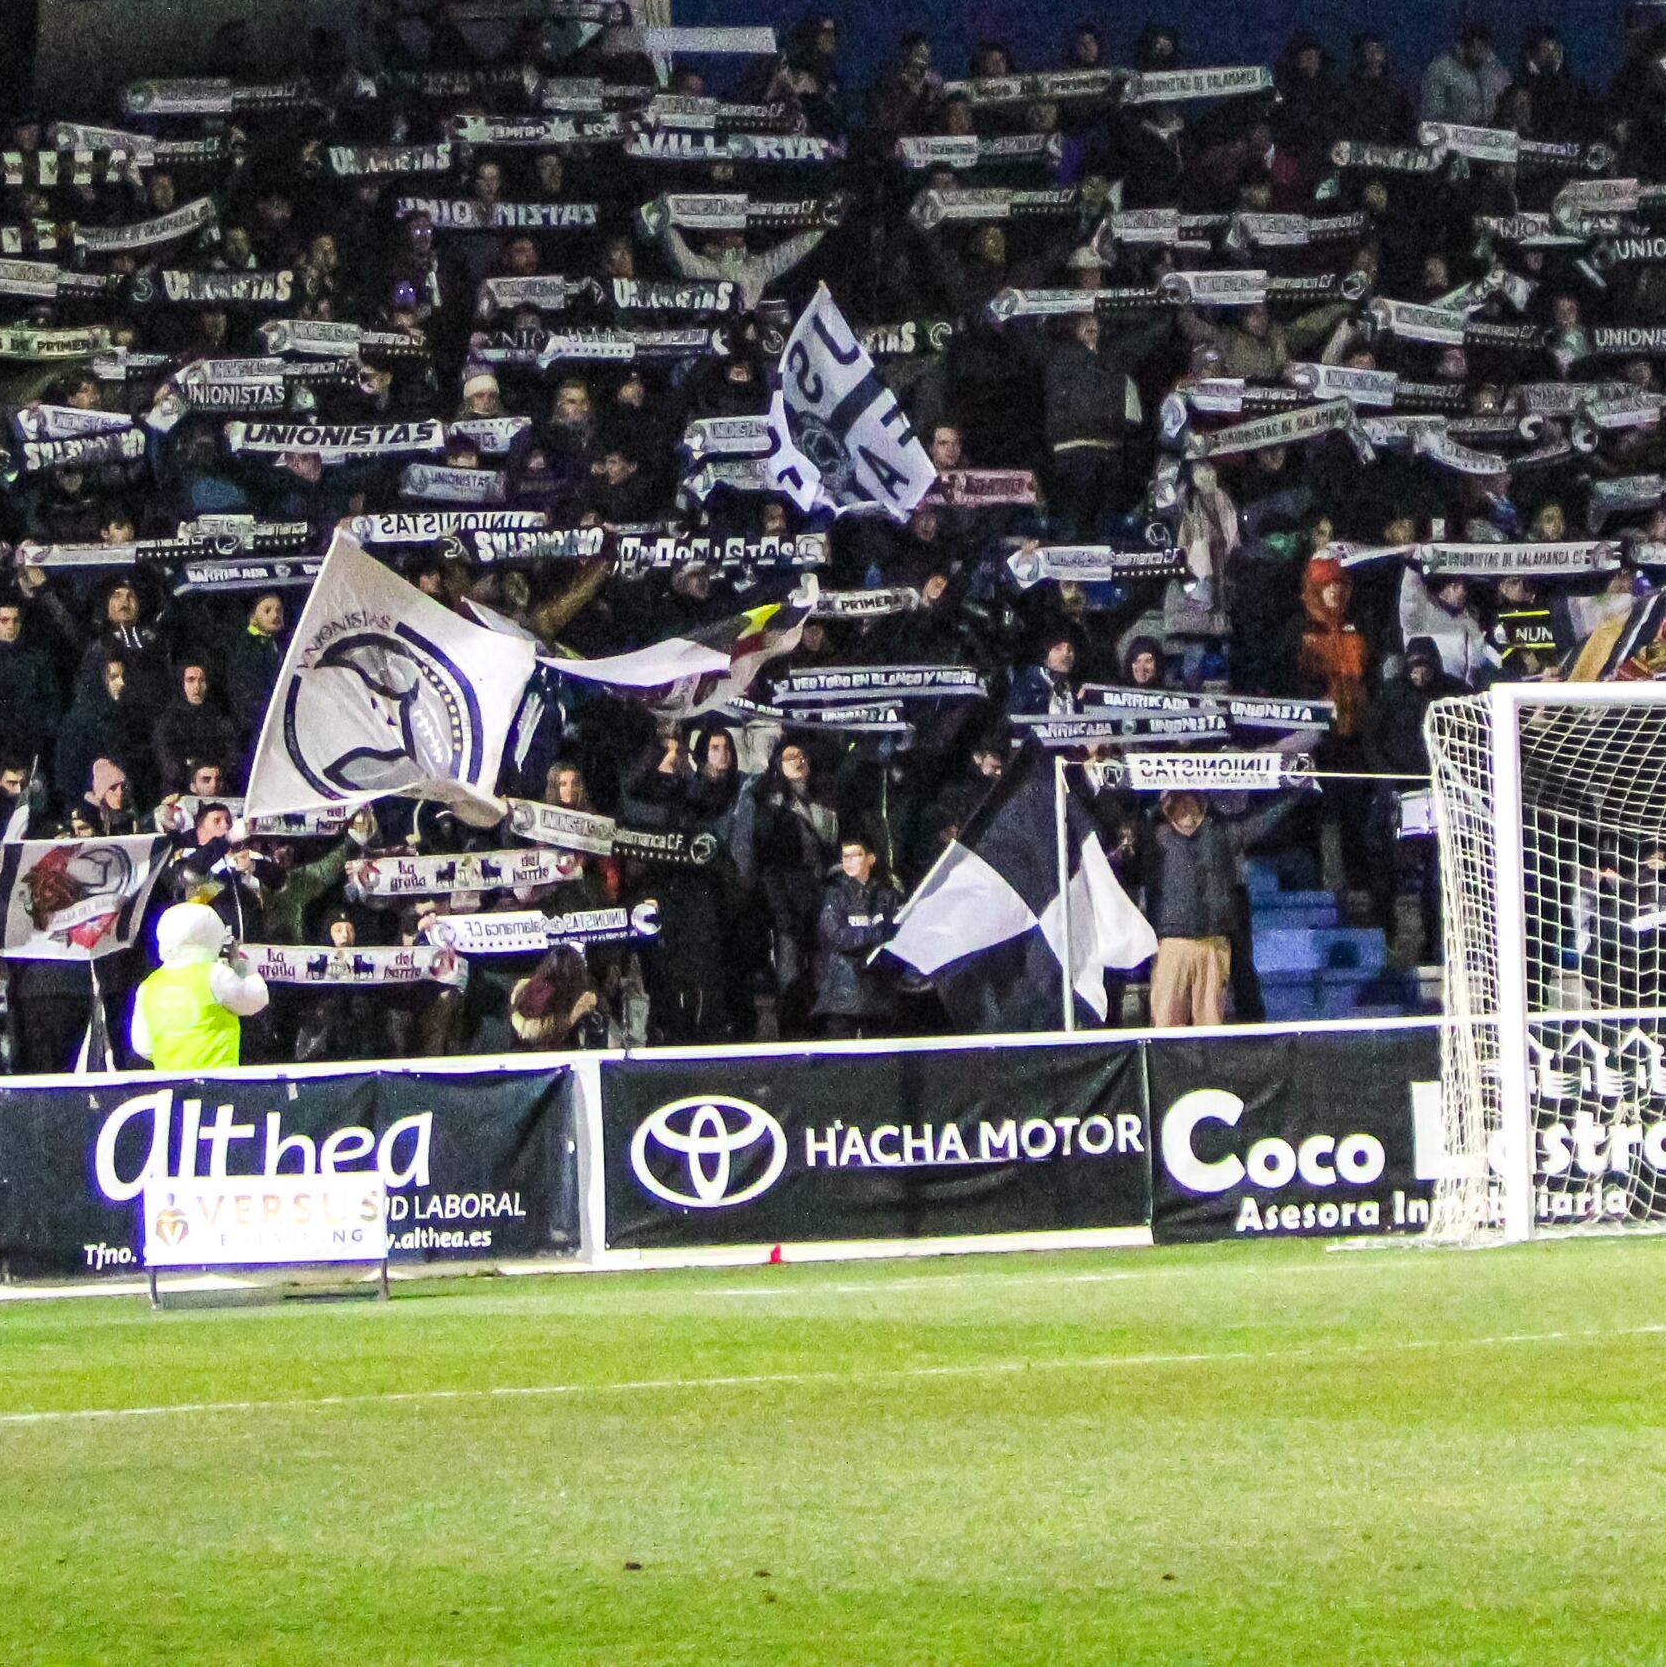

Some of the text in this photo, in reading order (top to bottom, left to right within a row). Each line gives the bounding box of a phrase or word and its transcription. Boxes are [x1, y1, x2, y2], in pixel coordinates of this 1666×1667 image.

[635, 132, 826, 160] VILLORIA
[243, 421, 438, 447] UNIONISTAS
[622, 538, 798, 568] UNIONISTAS
[1514, 625, 1553, 643] NUN
[1149, 716, 1227, 733] UNIONISTA
[1229, 702, 1313, 722] UNIONISTA
[315, 815, 349, 833] barri
[520, 852, 540, 869] del
[394, 949, 414, 967] del
[804, 1113, 1145, 1168] HACHA MOTOR
[1160, 1088, 1386, 1193] Coco
[197, 1189, 380, 1227] VERSUS
[415, 1191, 527, 1220] LABORAL
[1236, 1197, 1380, 1233] Asesora
[83, 1243, 137, 1270] Tfno.
